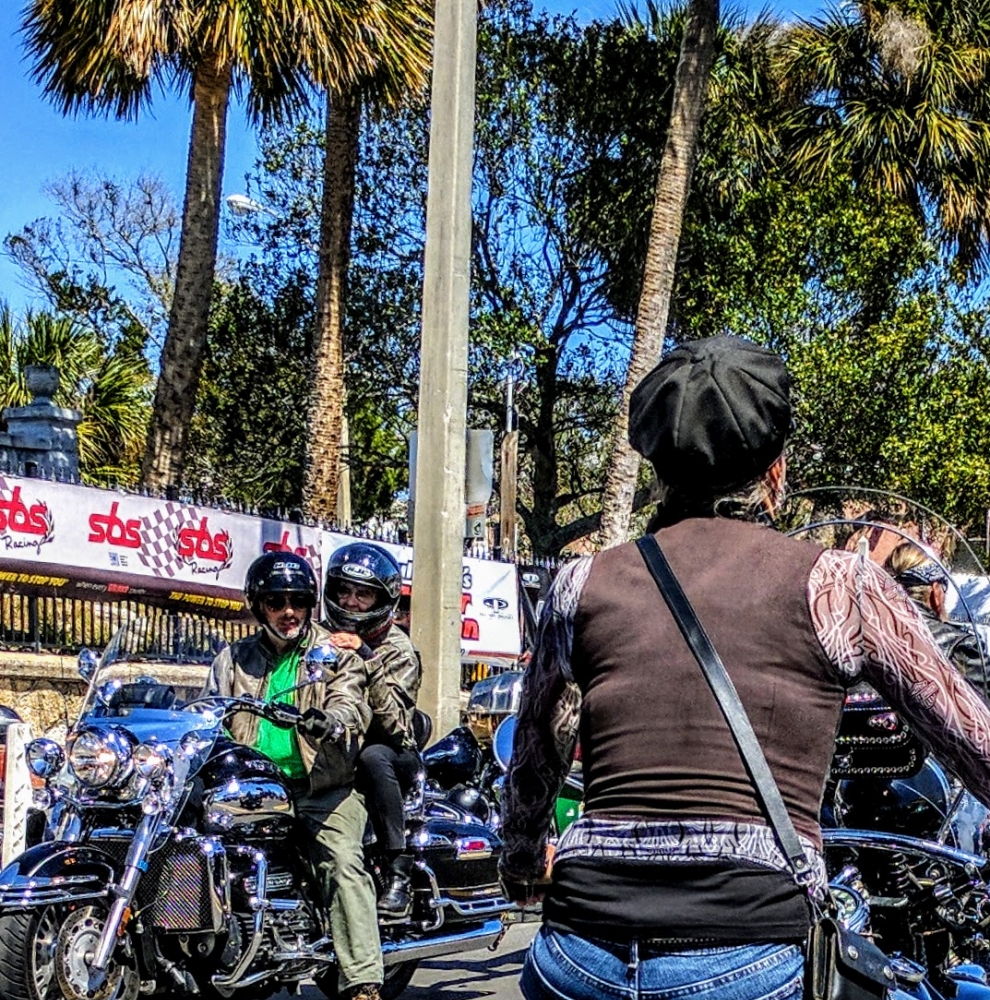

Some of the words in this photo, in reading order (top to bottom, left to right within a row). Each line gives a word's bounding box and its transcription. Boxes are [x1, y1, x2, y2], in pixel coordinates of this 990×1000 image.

[88, 501, 142, 549] sbs
[4, 536, 42, 555] Racing
[178, 516, 228, 562] sbs
[17, 573, 28, 583] TO
[28, 574, 49, 585] STOP
[190, 563, 220, 580] Racing
[181, 593, 207, 605] POWER
[213, 598, 230, 609] STOP
